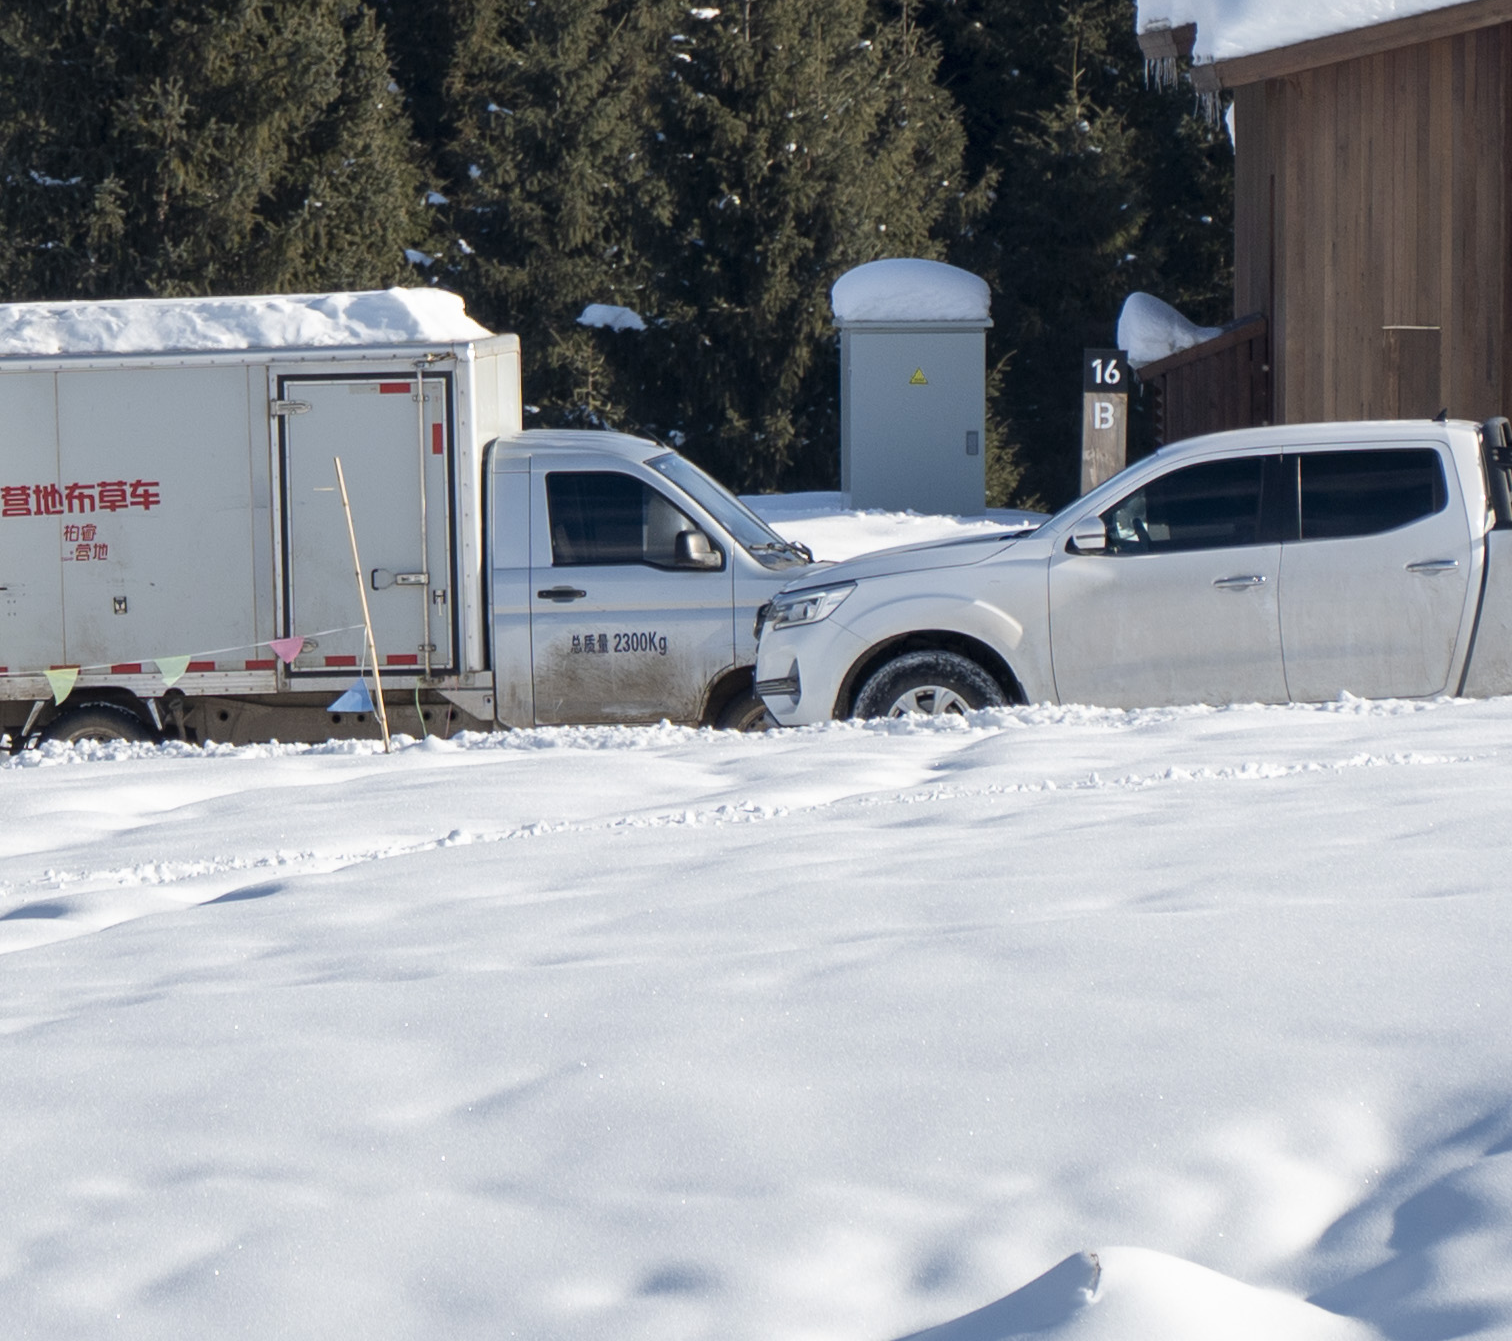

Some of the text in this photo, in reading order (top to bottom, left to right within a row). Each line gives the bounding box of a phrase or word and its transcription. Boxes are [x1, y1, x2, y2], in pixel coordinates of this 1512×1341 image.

[1091, 358, 1121, 385] 16
[1094, 402, 1115, 430] B
[0, 479, 161, 517] 营地布草车
[63, 523, 97, 542] 柏睿
[75, 543, 108, 561] 营地
[570, 631, 668, 656] 总质量 2300Kg
